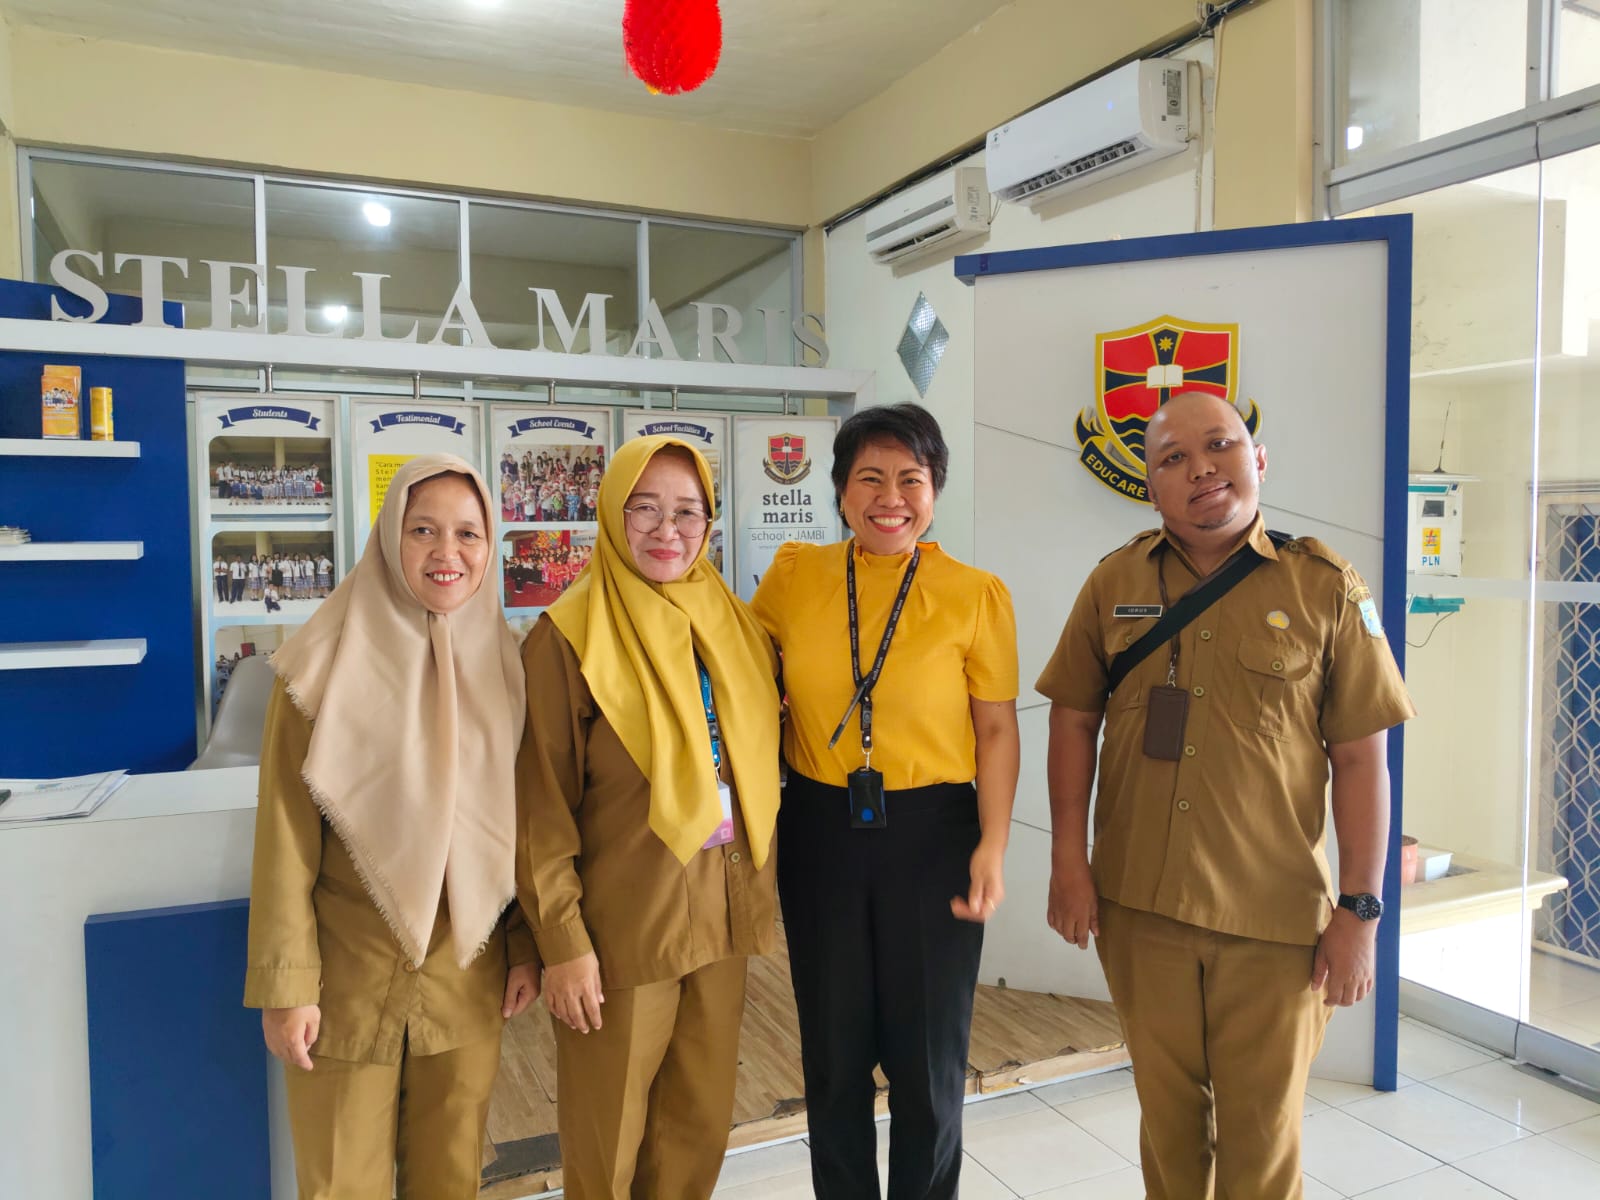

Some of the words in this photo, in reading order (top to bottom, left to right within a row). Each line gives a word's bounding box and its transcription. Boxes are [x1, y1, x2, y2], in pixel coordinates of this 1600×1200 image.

[50, 248, 498, 350] STELLA
[528, 287, 830, 368] MARIS
[252, 408, 288, 418] Students
[396, 413, 441, 424] Testimonial
[529, 419, 553, 428] School
[553, 419, 576, 429] Events
[652, 424, 673, 433] School
[1085, 453, 1146, 498] EDUCARE
[762, 489, 812, 506] stella
[762, 508, 814, 524] maris
[751, 530, 786, 541] school
[794, 529, 825, 540] JAMBI
[1422, 556, 1441, 566] PLN
